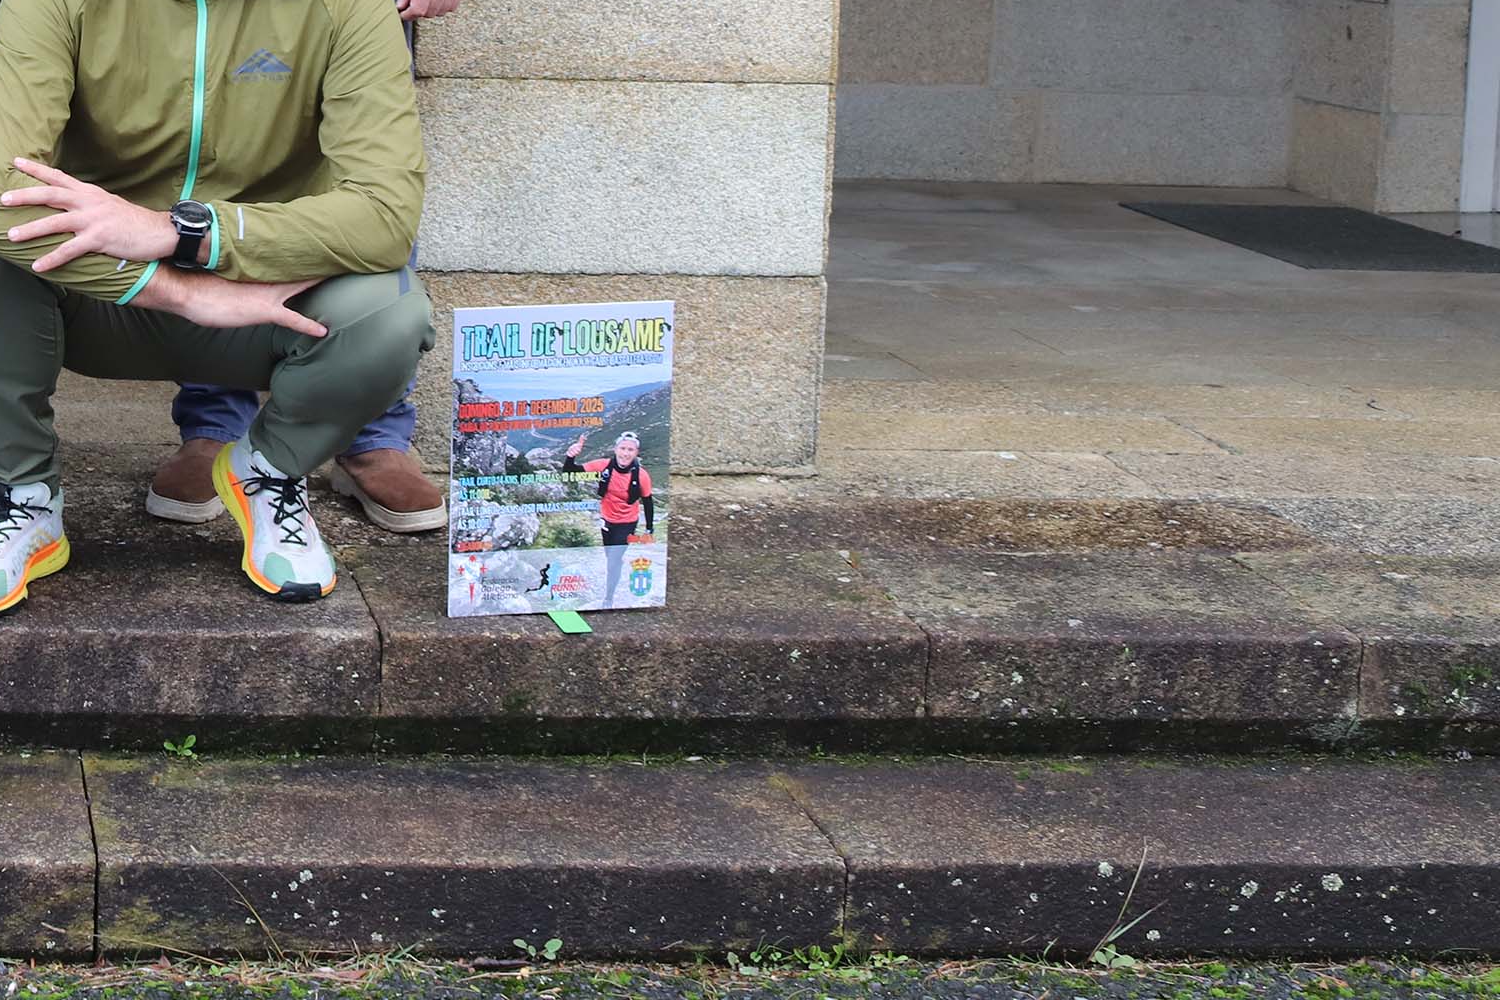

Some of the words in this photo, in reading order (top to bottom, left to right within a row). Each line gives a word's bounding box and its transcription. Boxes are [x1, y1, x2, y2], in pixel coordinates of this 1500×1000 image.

[460, 322, 526, 361] TRAIL
[530, 321, 557, 357] DE
[562, 316, 665, 356] LOUSAME
[579, 396, 604, 413] 2025
